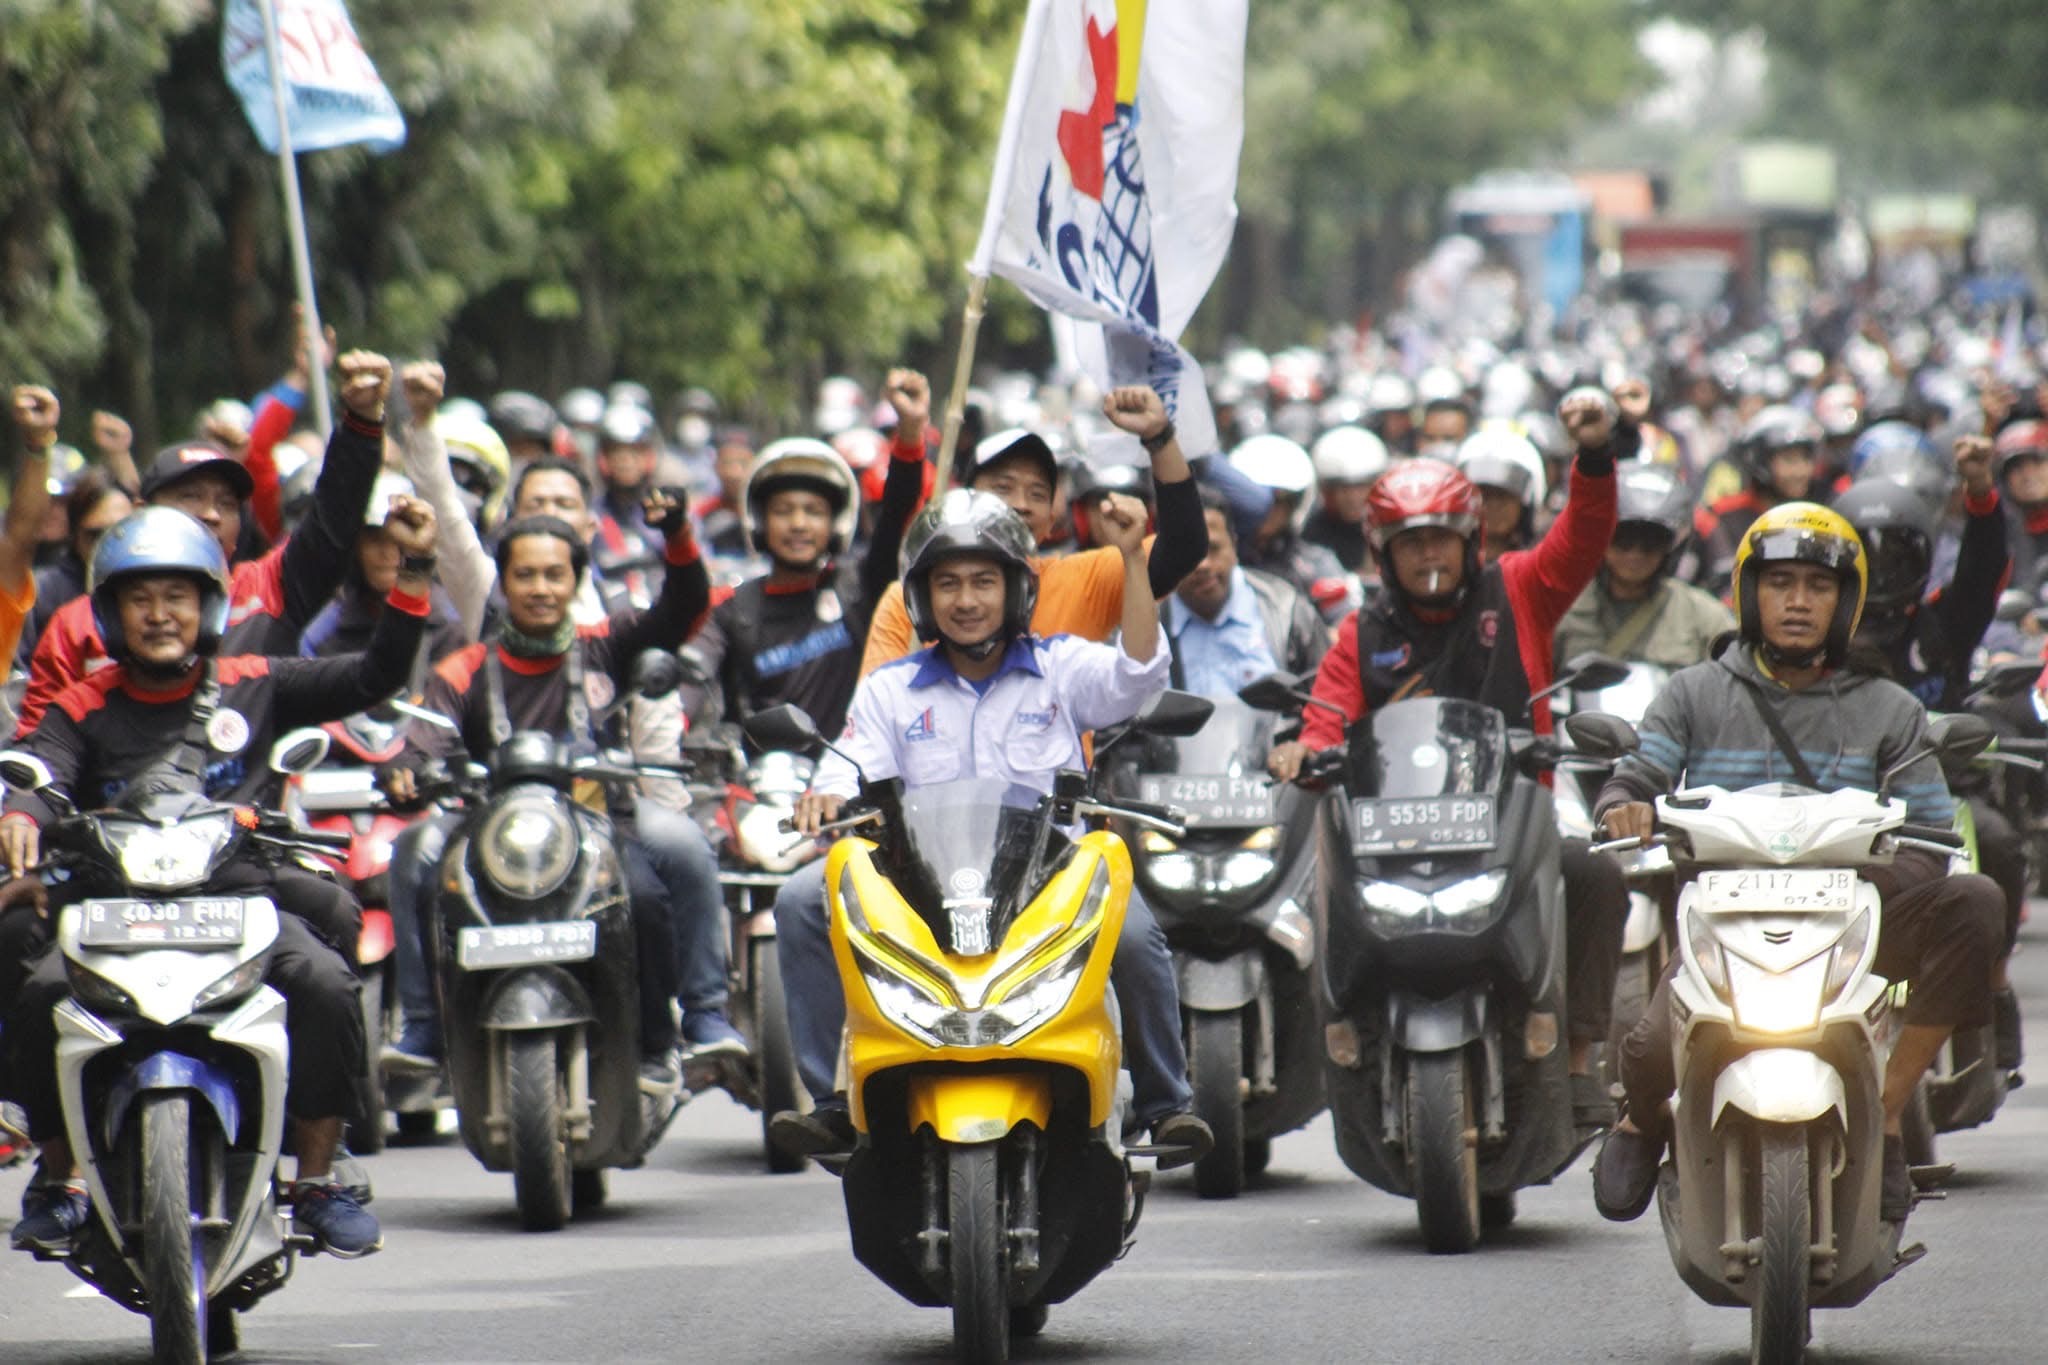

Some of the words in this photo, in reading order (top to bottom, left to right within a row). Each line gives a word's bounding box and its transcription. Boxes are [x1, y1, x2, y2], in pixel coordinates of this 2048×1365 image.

[1171, 780, 1220, 801] 4260
[1361, 806, 1375, 828] B
[1388, 803, 1441, 826] 5535
[1450, 801, 1489, 823] FDP
[1708, 875, 1721, 892] F
[1737, 873, 1793, 890] 2117
[1823, 873, 1849, 890] JB
[90, 903, 106, 922] B
